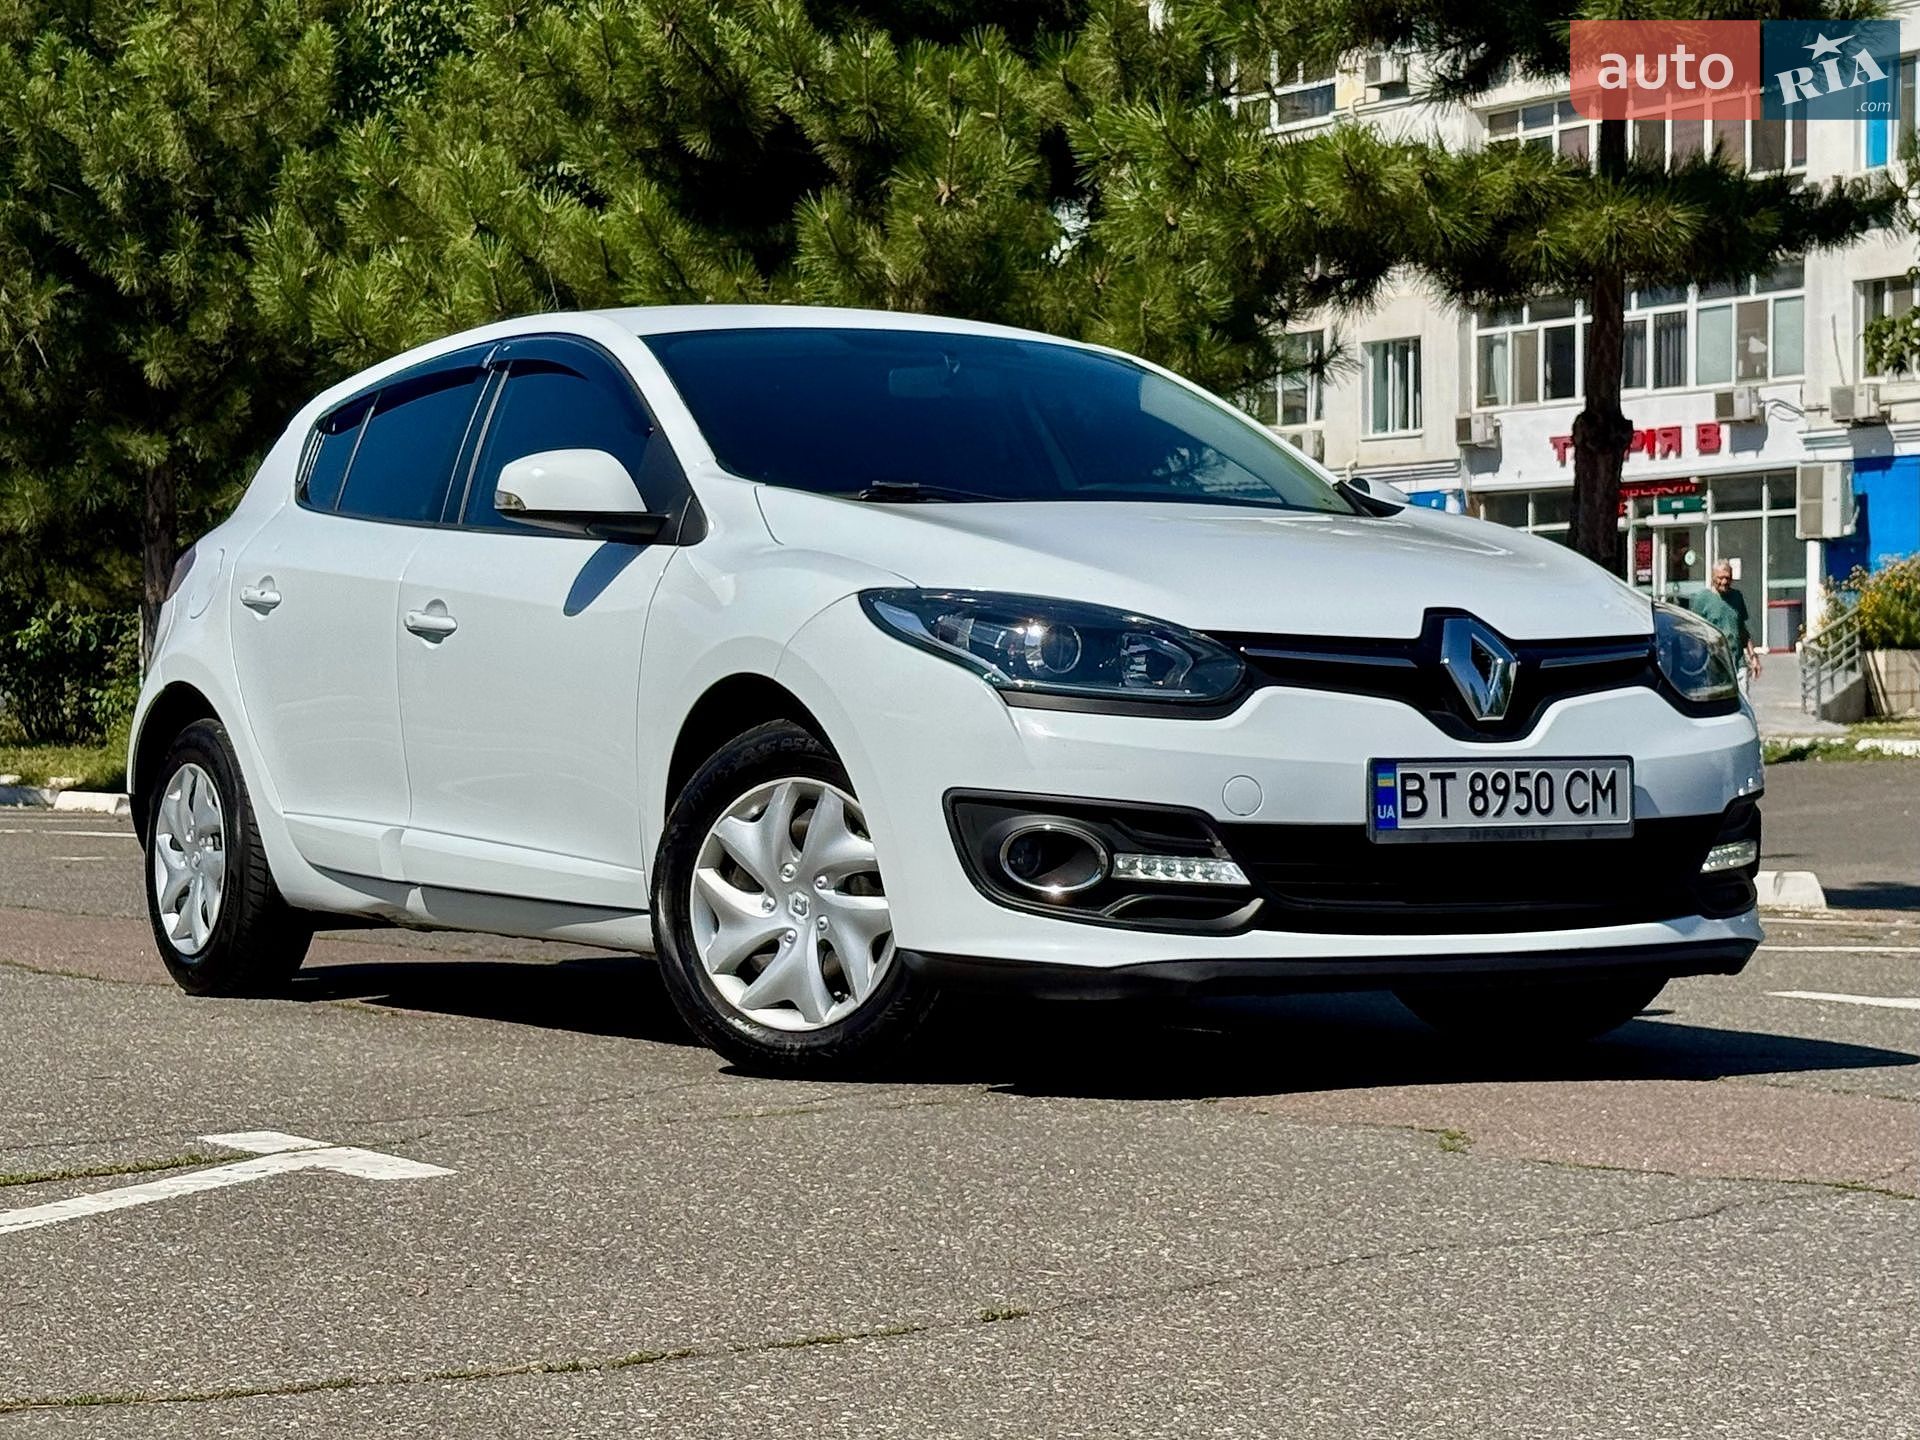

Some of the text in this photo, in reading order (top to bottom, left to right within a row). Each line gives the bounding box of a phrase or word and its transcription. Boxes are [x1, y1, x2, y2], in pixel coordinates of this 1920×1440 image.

[1400, 768, 1617, 819] BT 8950 CM
[1377, 805, 1396, 819] UA
